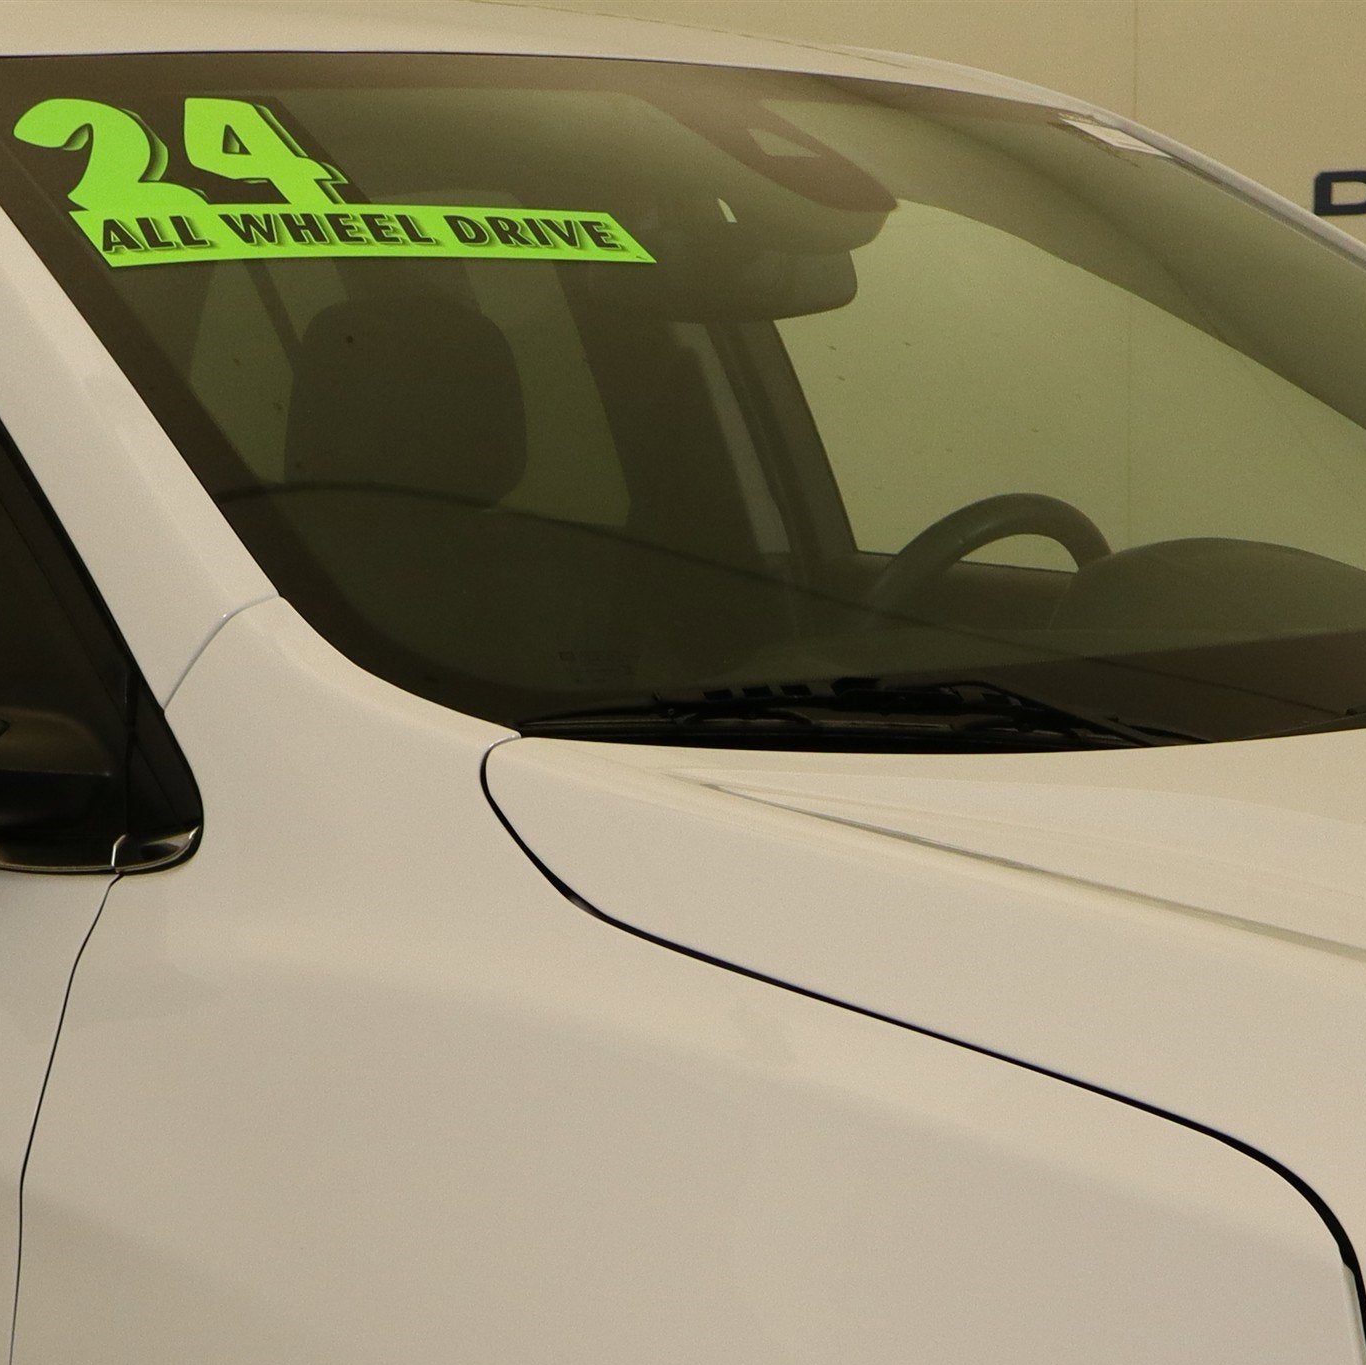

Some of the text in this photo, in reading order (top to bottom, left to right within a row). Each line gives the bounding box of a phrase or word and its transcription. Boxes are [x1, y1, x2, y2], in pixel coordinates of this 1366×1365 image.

[14, 98, 350, 212] 24
[100, 211, 628, 254] ALL WHEEL DRIVE
